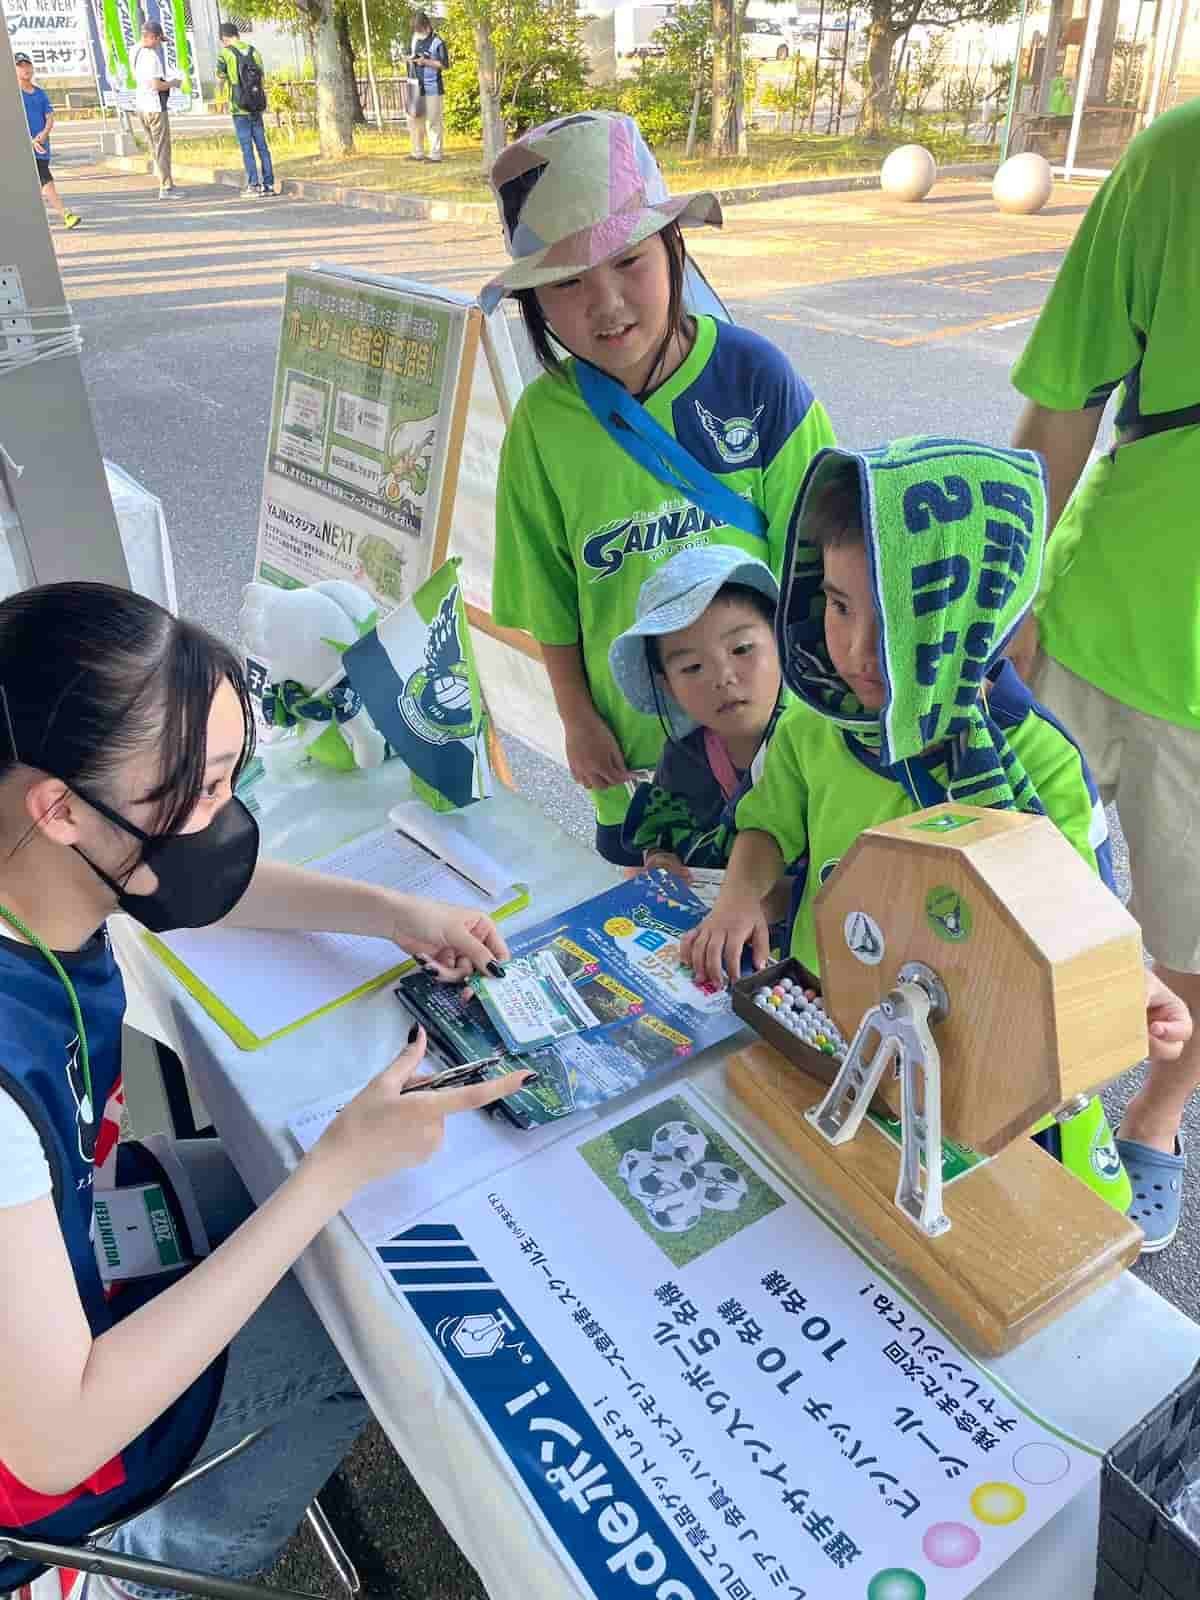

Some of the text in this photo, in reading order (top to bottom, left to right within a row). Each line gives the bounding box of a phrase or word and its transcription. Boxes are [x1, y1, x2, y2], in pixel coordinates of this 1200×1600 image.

[653, 1321, 863, 1569] 選手サイン入りボール
[881, 1340, 1001, 1453] 残念また次回
[893, 1406, 969, 1479] シール
[593, 1395, 757, 1600] 回して景品ゲットしよう！
[802, 1397, 922, 1520] ピンバッチ
